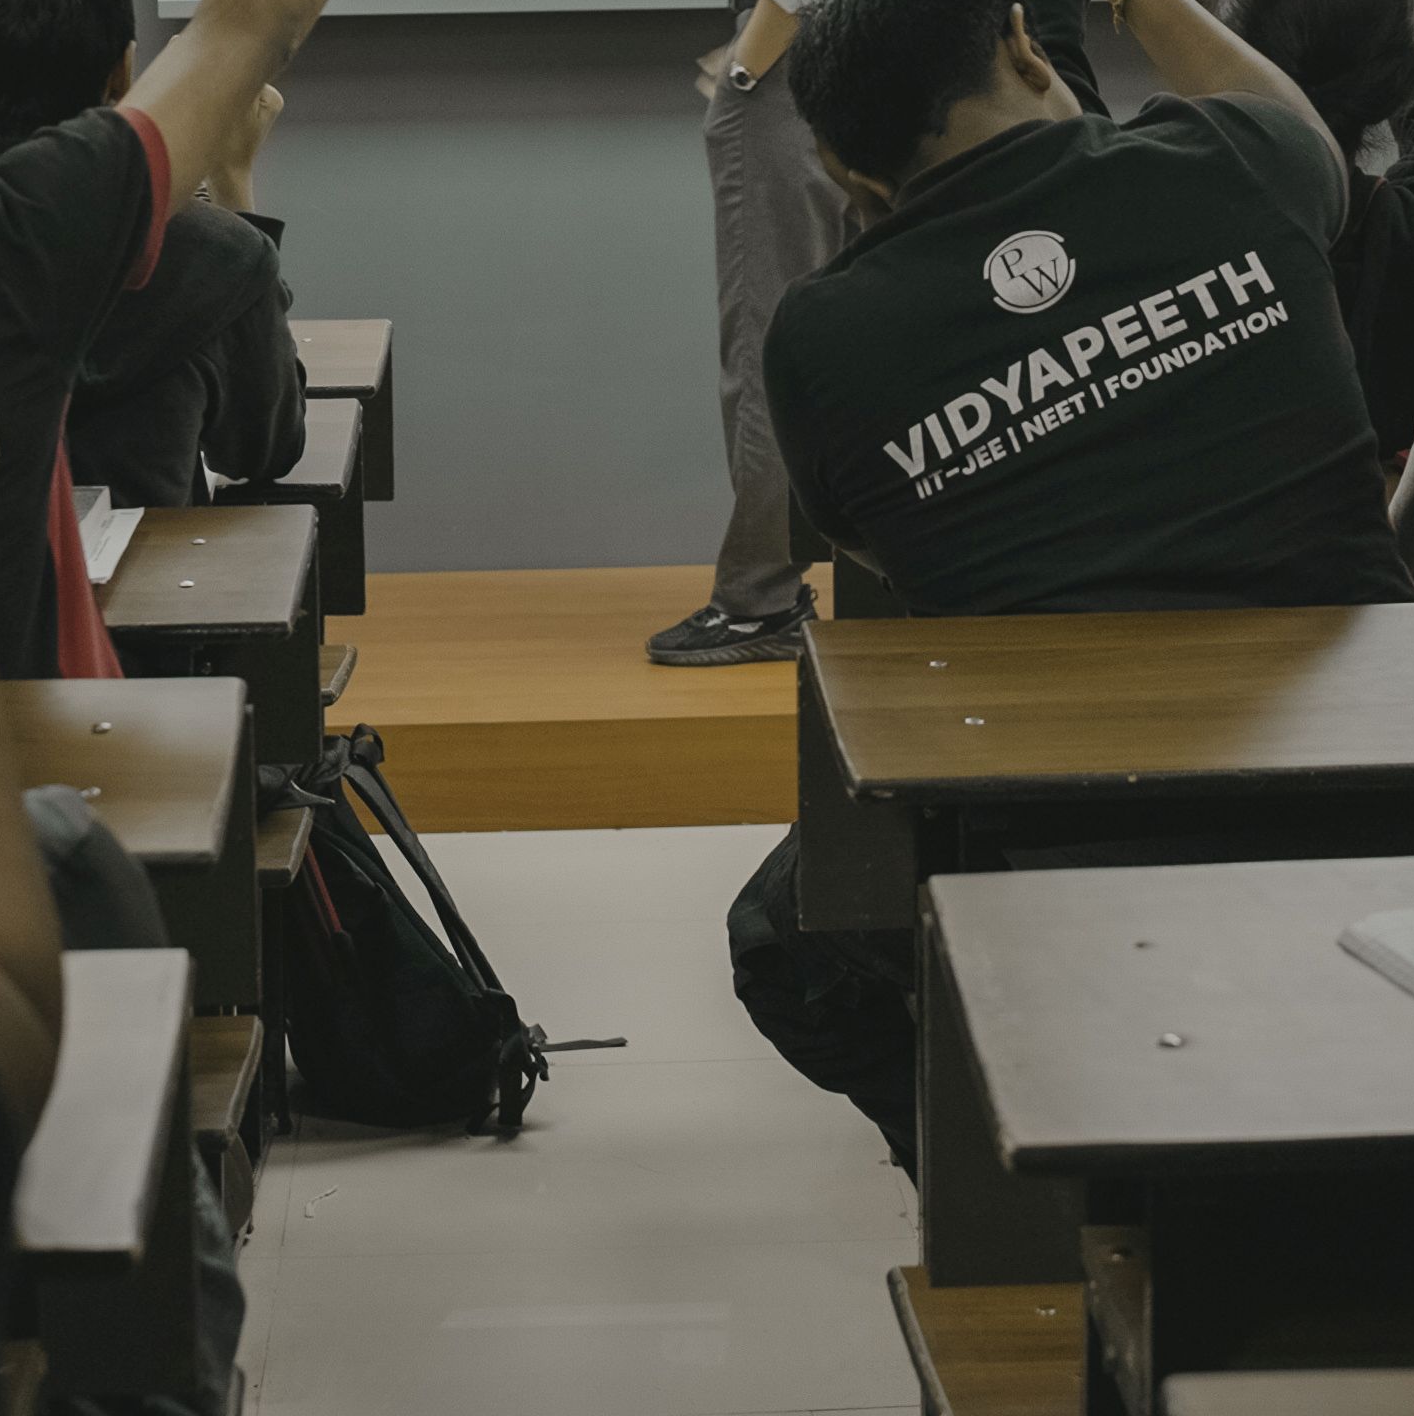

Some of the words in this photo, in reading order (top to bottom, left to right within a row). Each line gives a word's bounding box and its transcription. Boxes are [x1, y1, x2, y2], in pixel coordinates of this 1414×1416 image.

[883, 250, 1277, 478] VIDYAPEETH
[915, 436, 1009, 501] IIT-JEE
[1023, 391, 1087, 443] NEET
[1104, 300, 1290, 399] FOUNDATION
